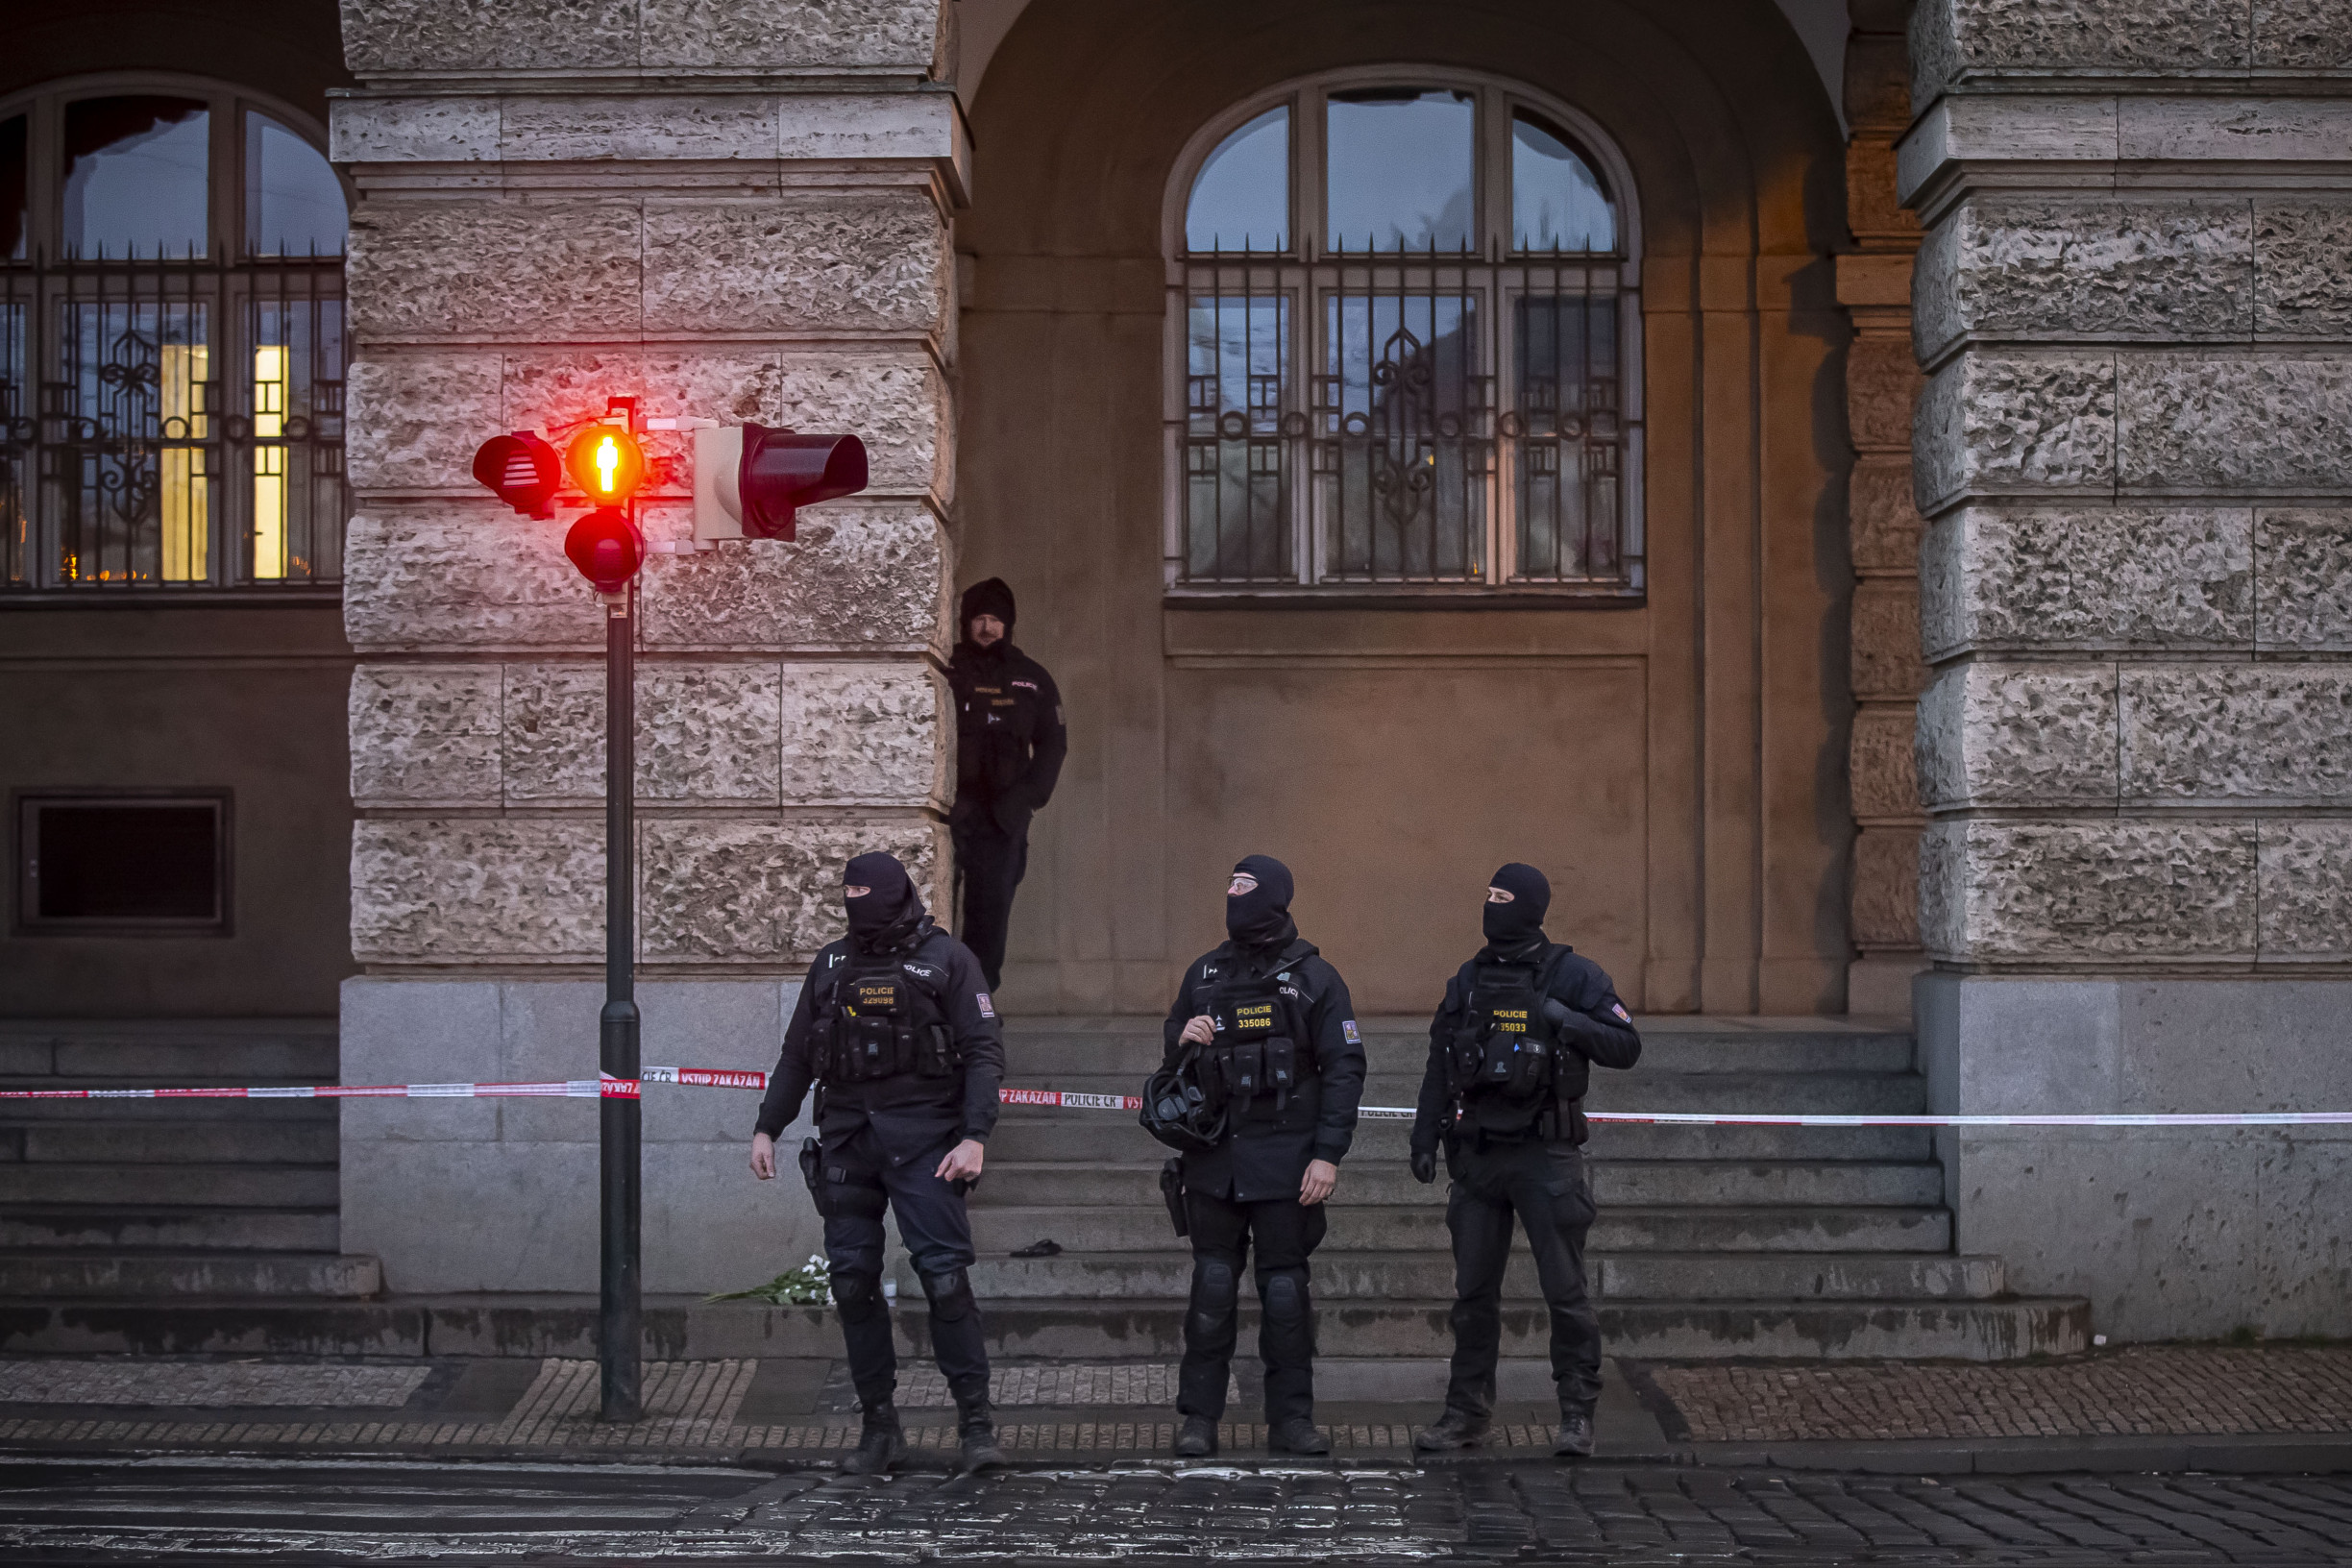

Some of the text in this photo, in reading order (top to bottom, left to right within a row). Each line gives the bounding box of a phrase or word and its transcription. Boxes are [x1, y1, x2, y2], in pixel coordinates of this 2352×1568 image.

[860, 987, 894, 995] POLICIE
[1237, 1005, 1272, 1017] POLICIE
[1493, 1010, 1528, 1018] POLICIE
[1237, 1017, 1271, 1028] 335086
[1498, 1022, 1527, 1032] 35033
[681, 1072, 712, 1085] VSTUP
[1065, 1093, 1101, 1107] POLICIE
